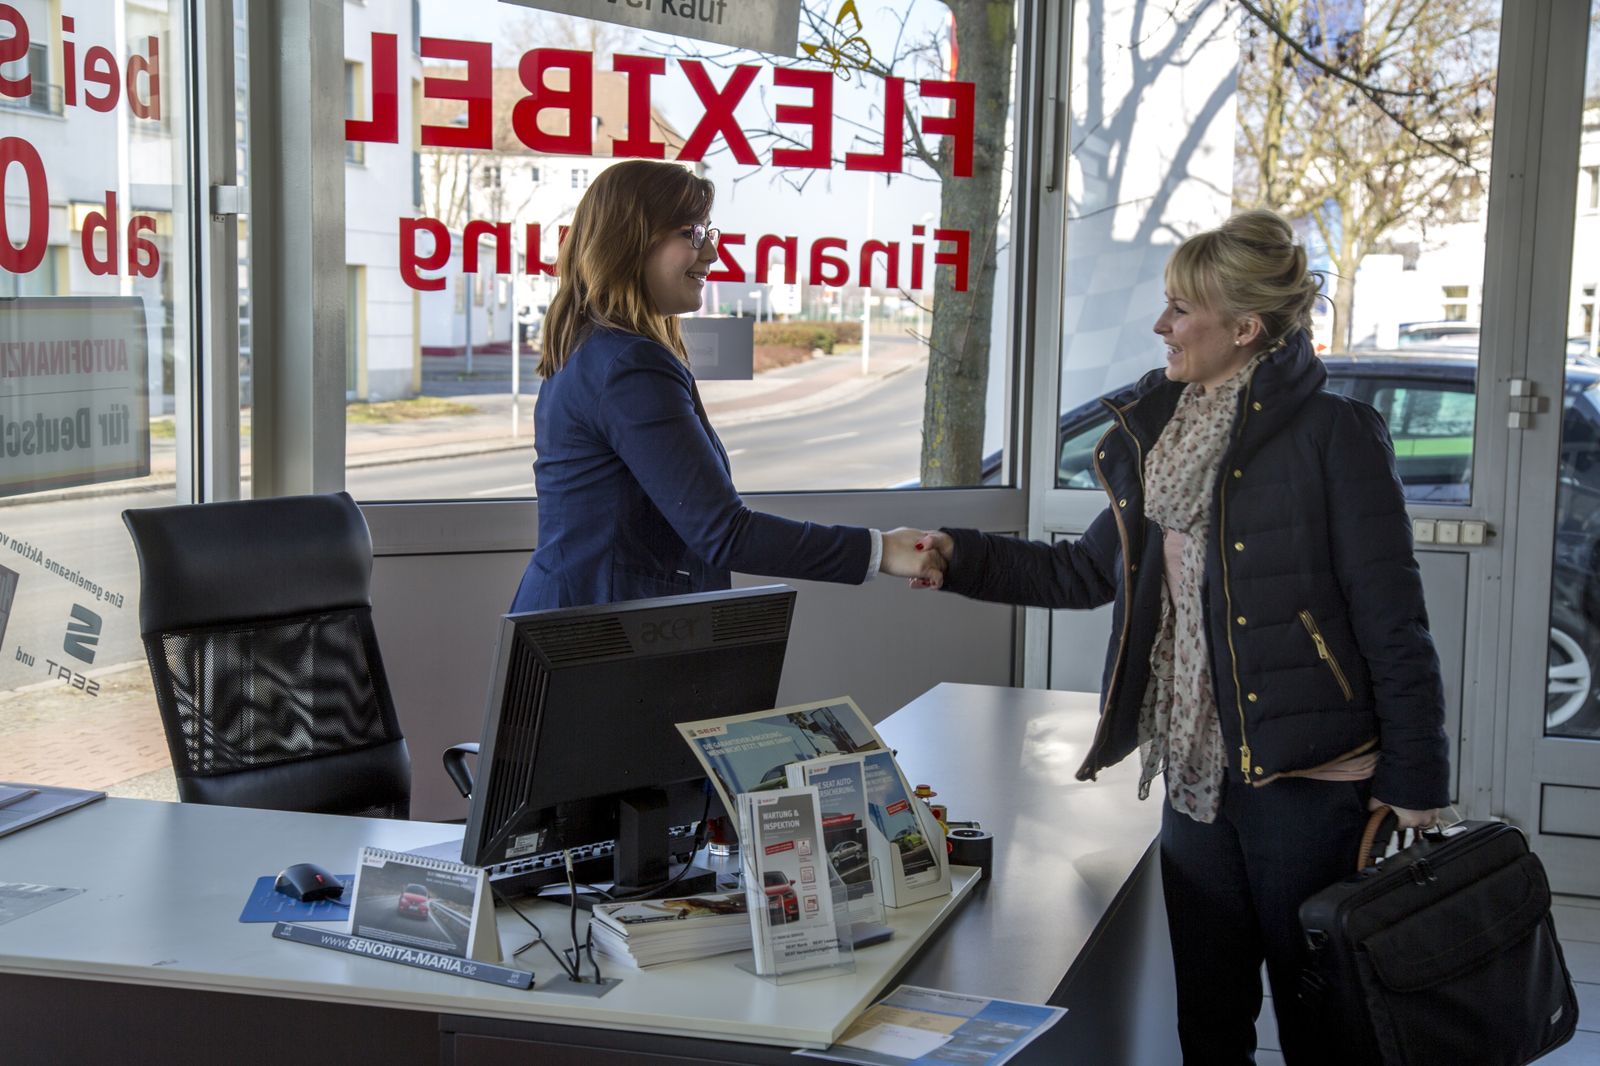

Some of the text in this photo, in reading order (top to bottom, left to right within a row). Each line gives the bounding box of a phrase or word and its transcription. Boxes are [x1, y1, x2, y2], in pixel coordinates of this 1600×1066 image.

[641, 615, 700, 643] acer
[696, 726, 721, 735] SEAT
[822, 780, 836, 789] SEAT
[762, 810, 793, 820] WARTUNG
[763, 820, 801, 830] INSPEKTION
[321, 935, 477, 976] www.SENORITA-MARIA.de
